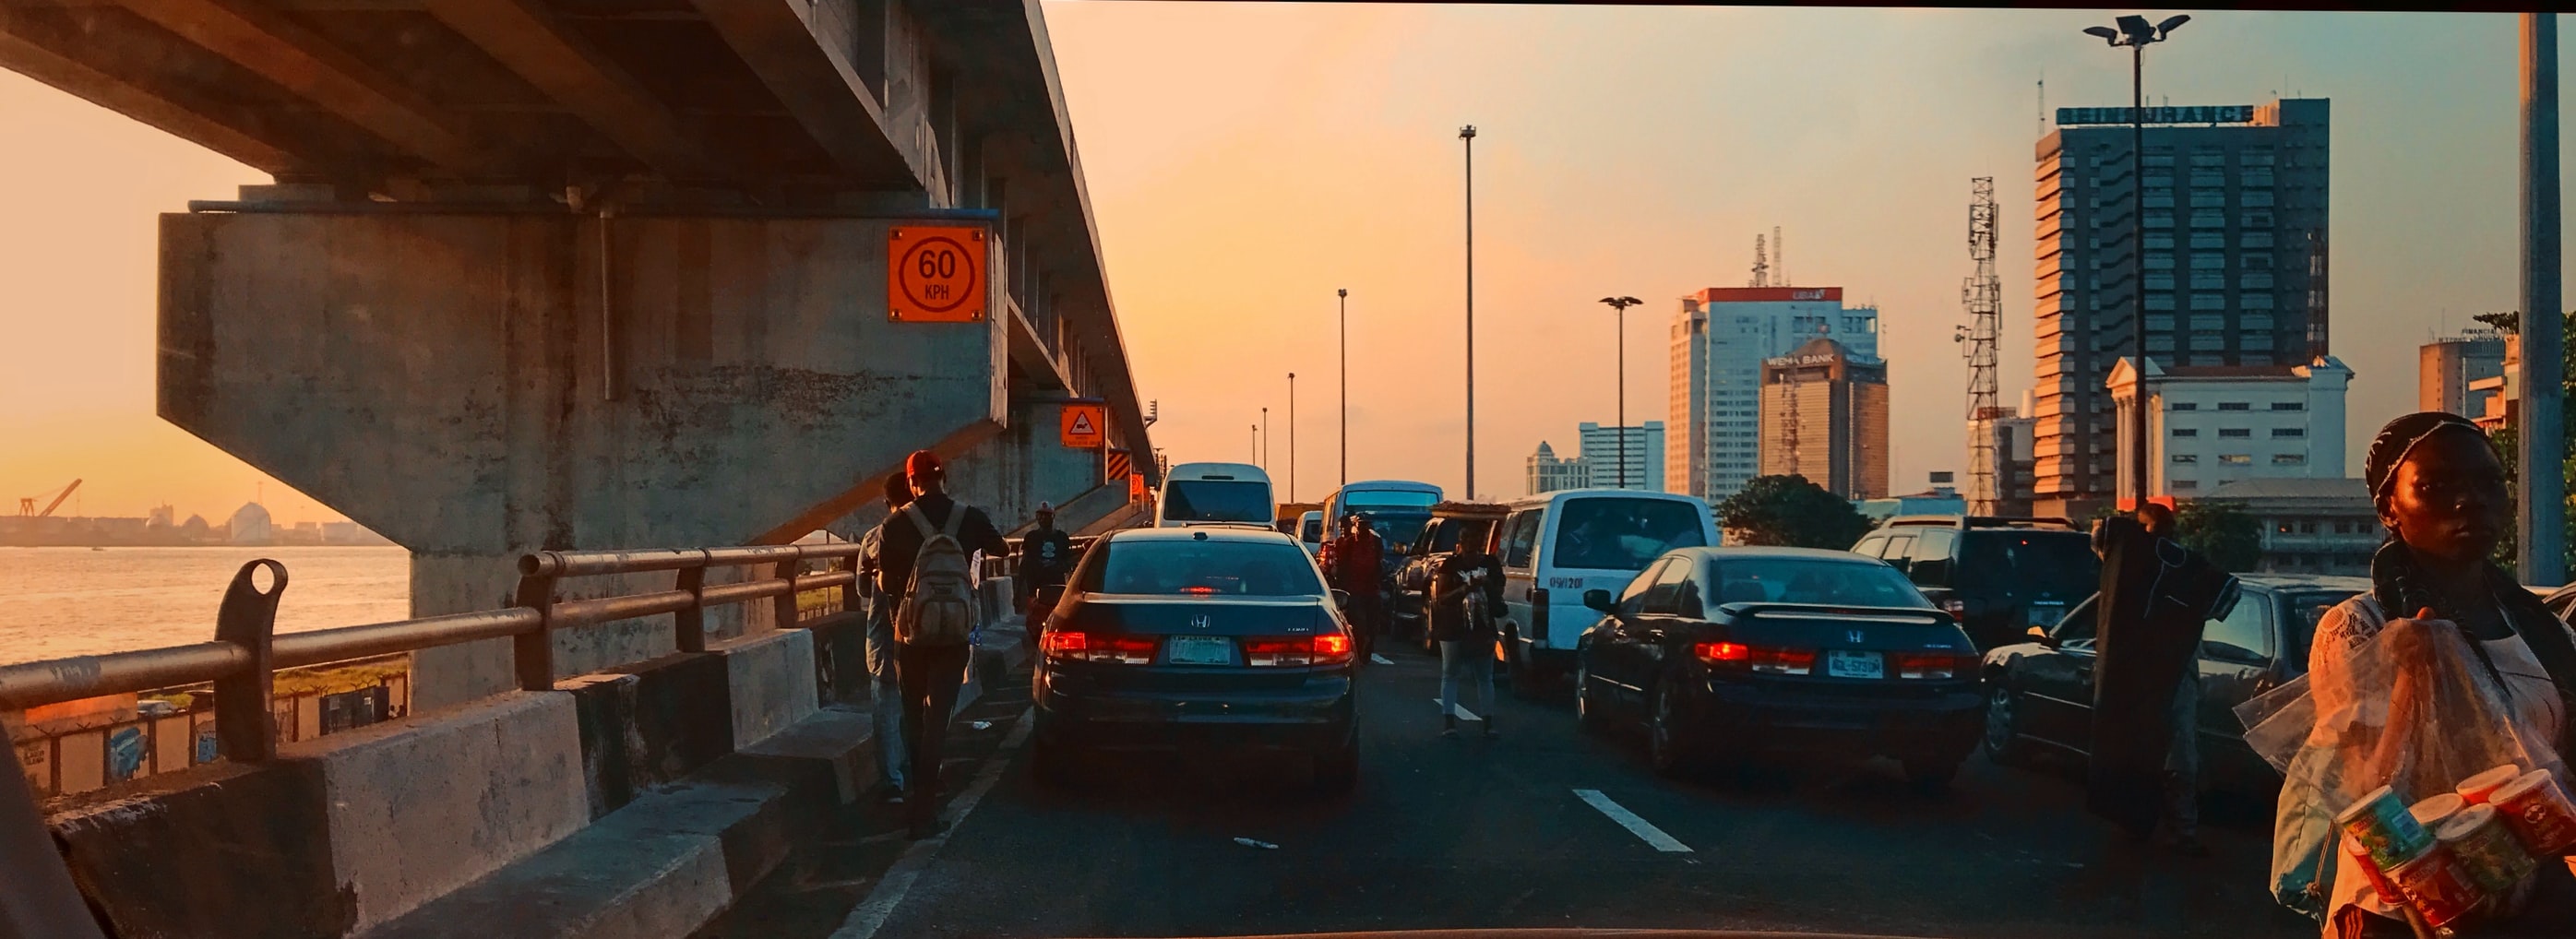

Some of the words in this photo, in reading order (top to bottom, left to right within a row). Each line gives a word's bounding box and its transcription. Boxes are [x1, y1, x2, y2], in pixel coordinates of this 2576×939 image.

[919, 250, 955, 279] 60
[925, 284, 949, 300] KPH
[1802, 354, 1834, 364] BANK
